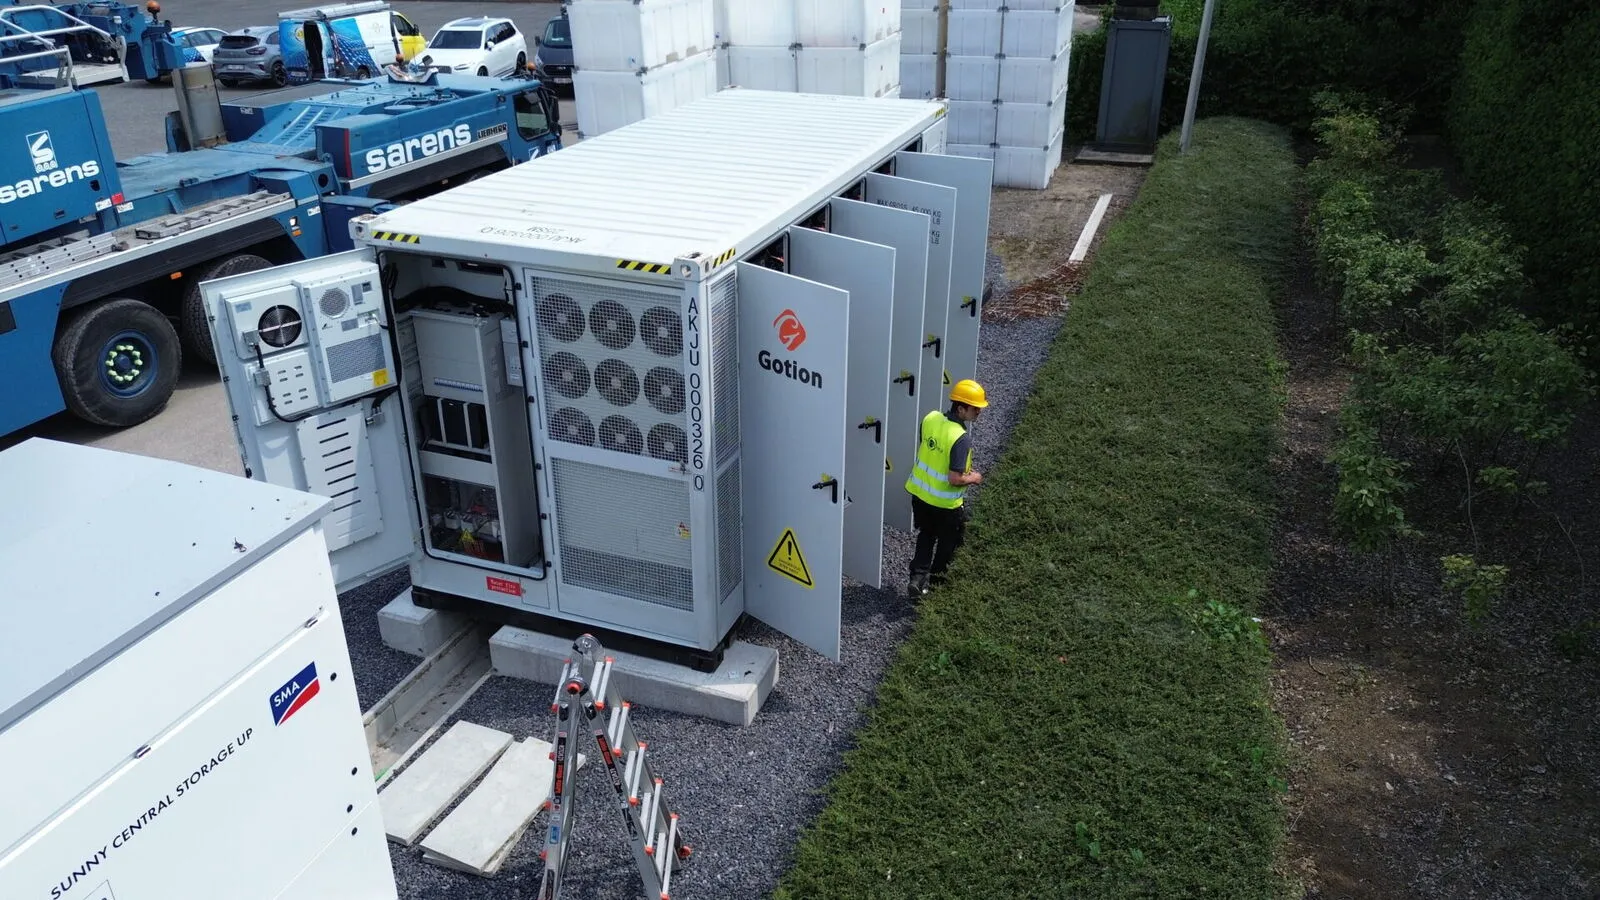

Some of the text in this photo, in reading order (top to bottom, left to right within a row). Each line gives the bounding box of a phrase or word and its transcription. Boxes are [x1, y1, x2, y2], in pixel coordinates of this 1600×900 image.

[366, 124, 471, 174] sarens
[477, 123, 507, 139] LIEBHERR
[0, 160, 100, 204] sarens
[758, 350, 822, 389] Gotion
[688, 297, 704, 490] AKJU 000326 0
[274, 681, 300, 707] SMA
[50, 727, 254, 900] SUNNY CENTRAL STORAGE UP
